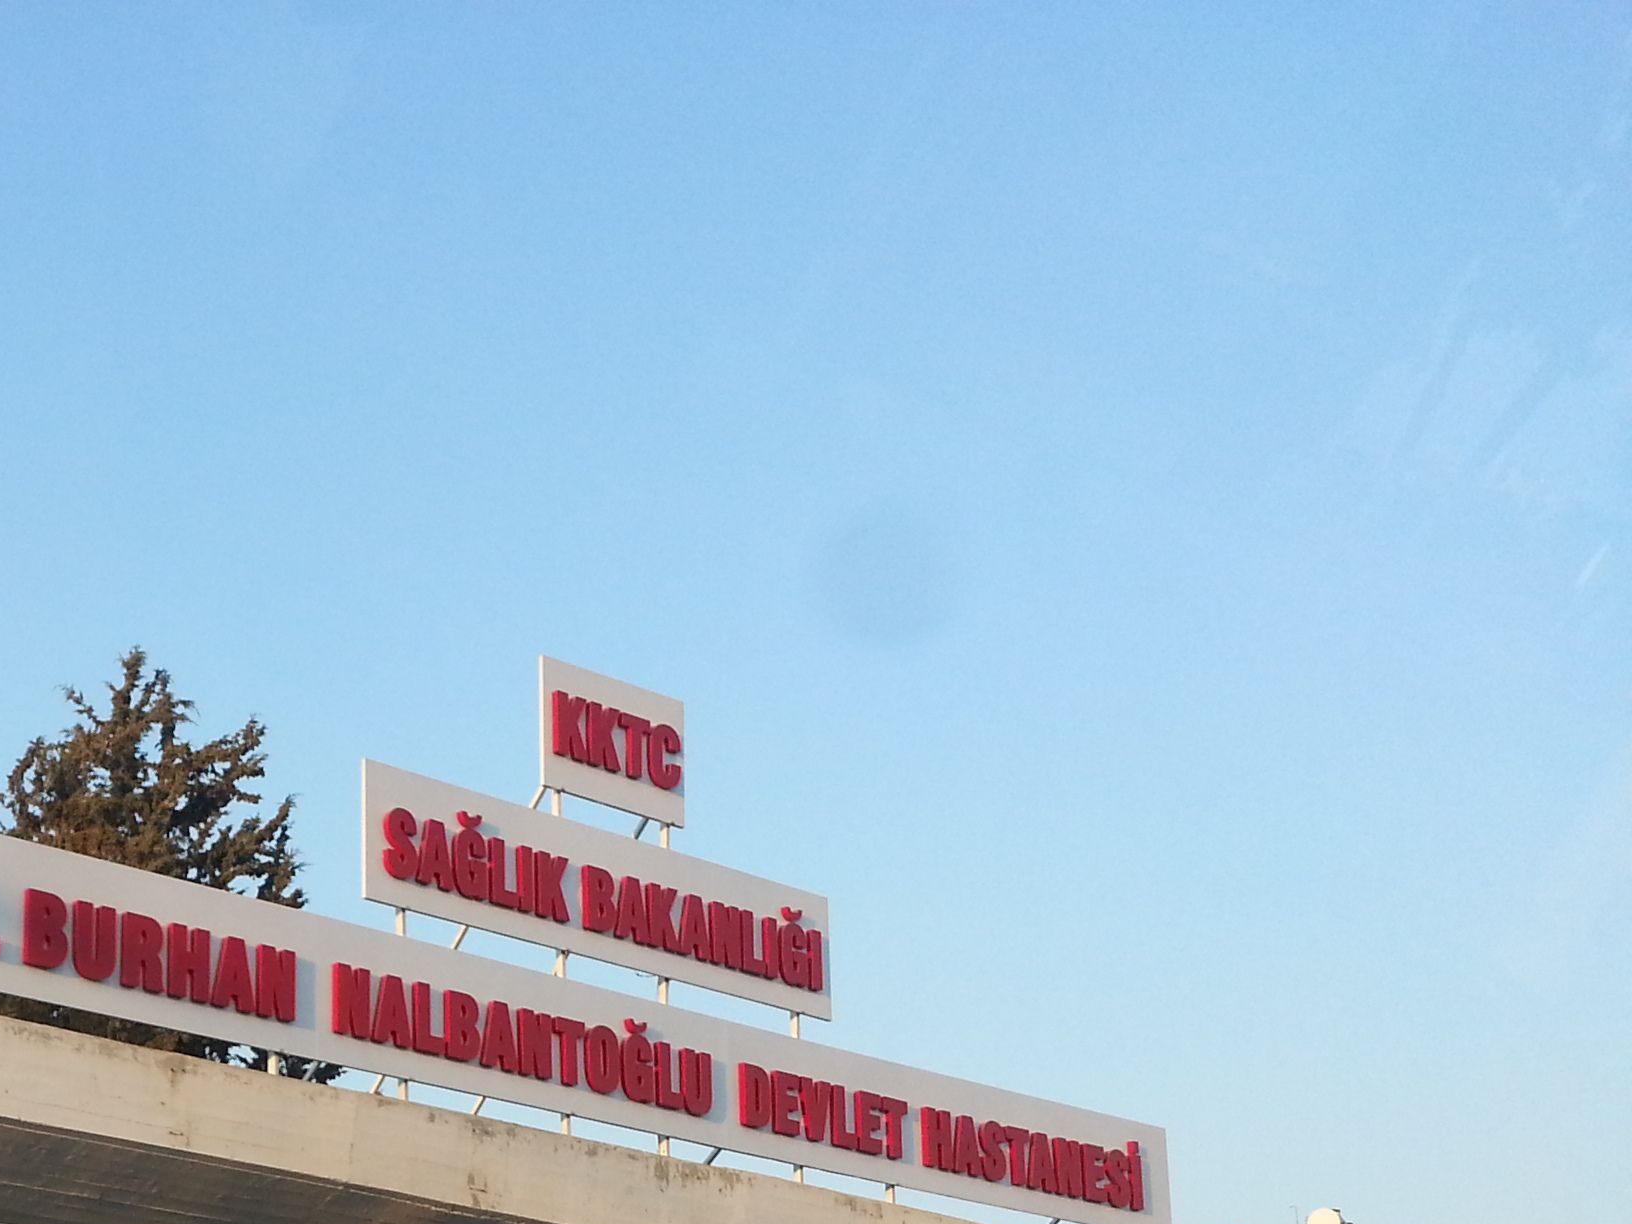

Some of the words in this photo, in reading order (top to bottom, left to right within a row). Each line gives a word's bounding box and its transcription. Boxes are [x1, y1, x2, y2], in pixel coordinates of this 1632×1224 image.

[552, 690, 681, 790] KKTC
[382, 808, 570, 923] SAĞLIK
[580, 865, 823, 992] BAKANLIĞI
[22, 888, 296, 1023] BURHAN
[331, 962, 712, 1117] NALBANTOĞLU
[738, 1062, 908, 1160] DEVLET
[920, 1106, 1145, 1212] HASTANESİ
